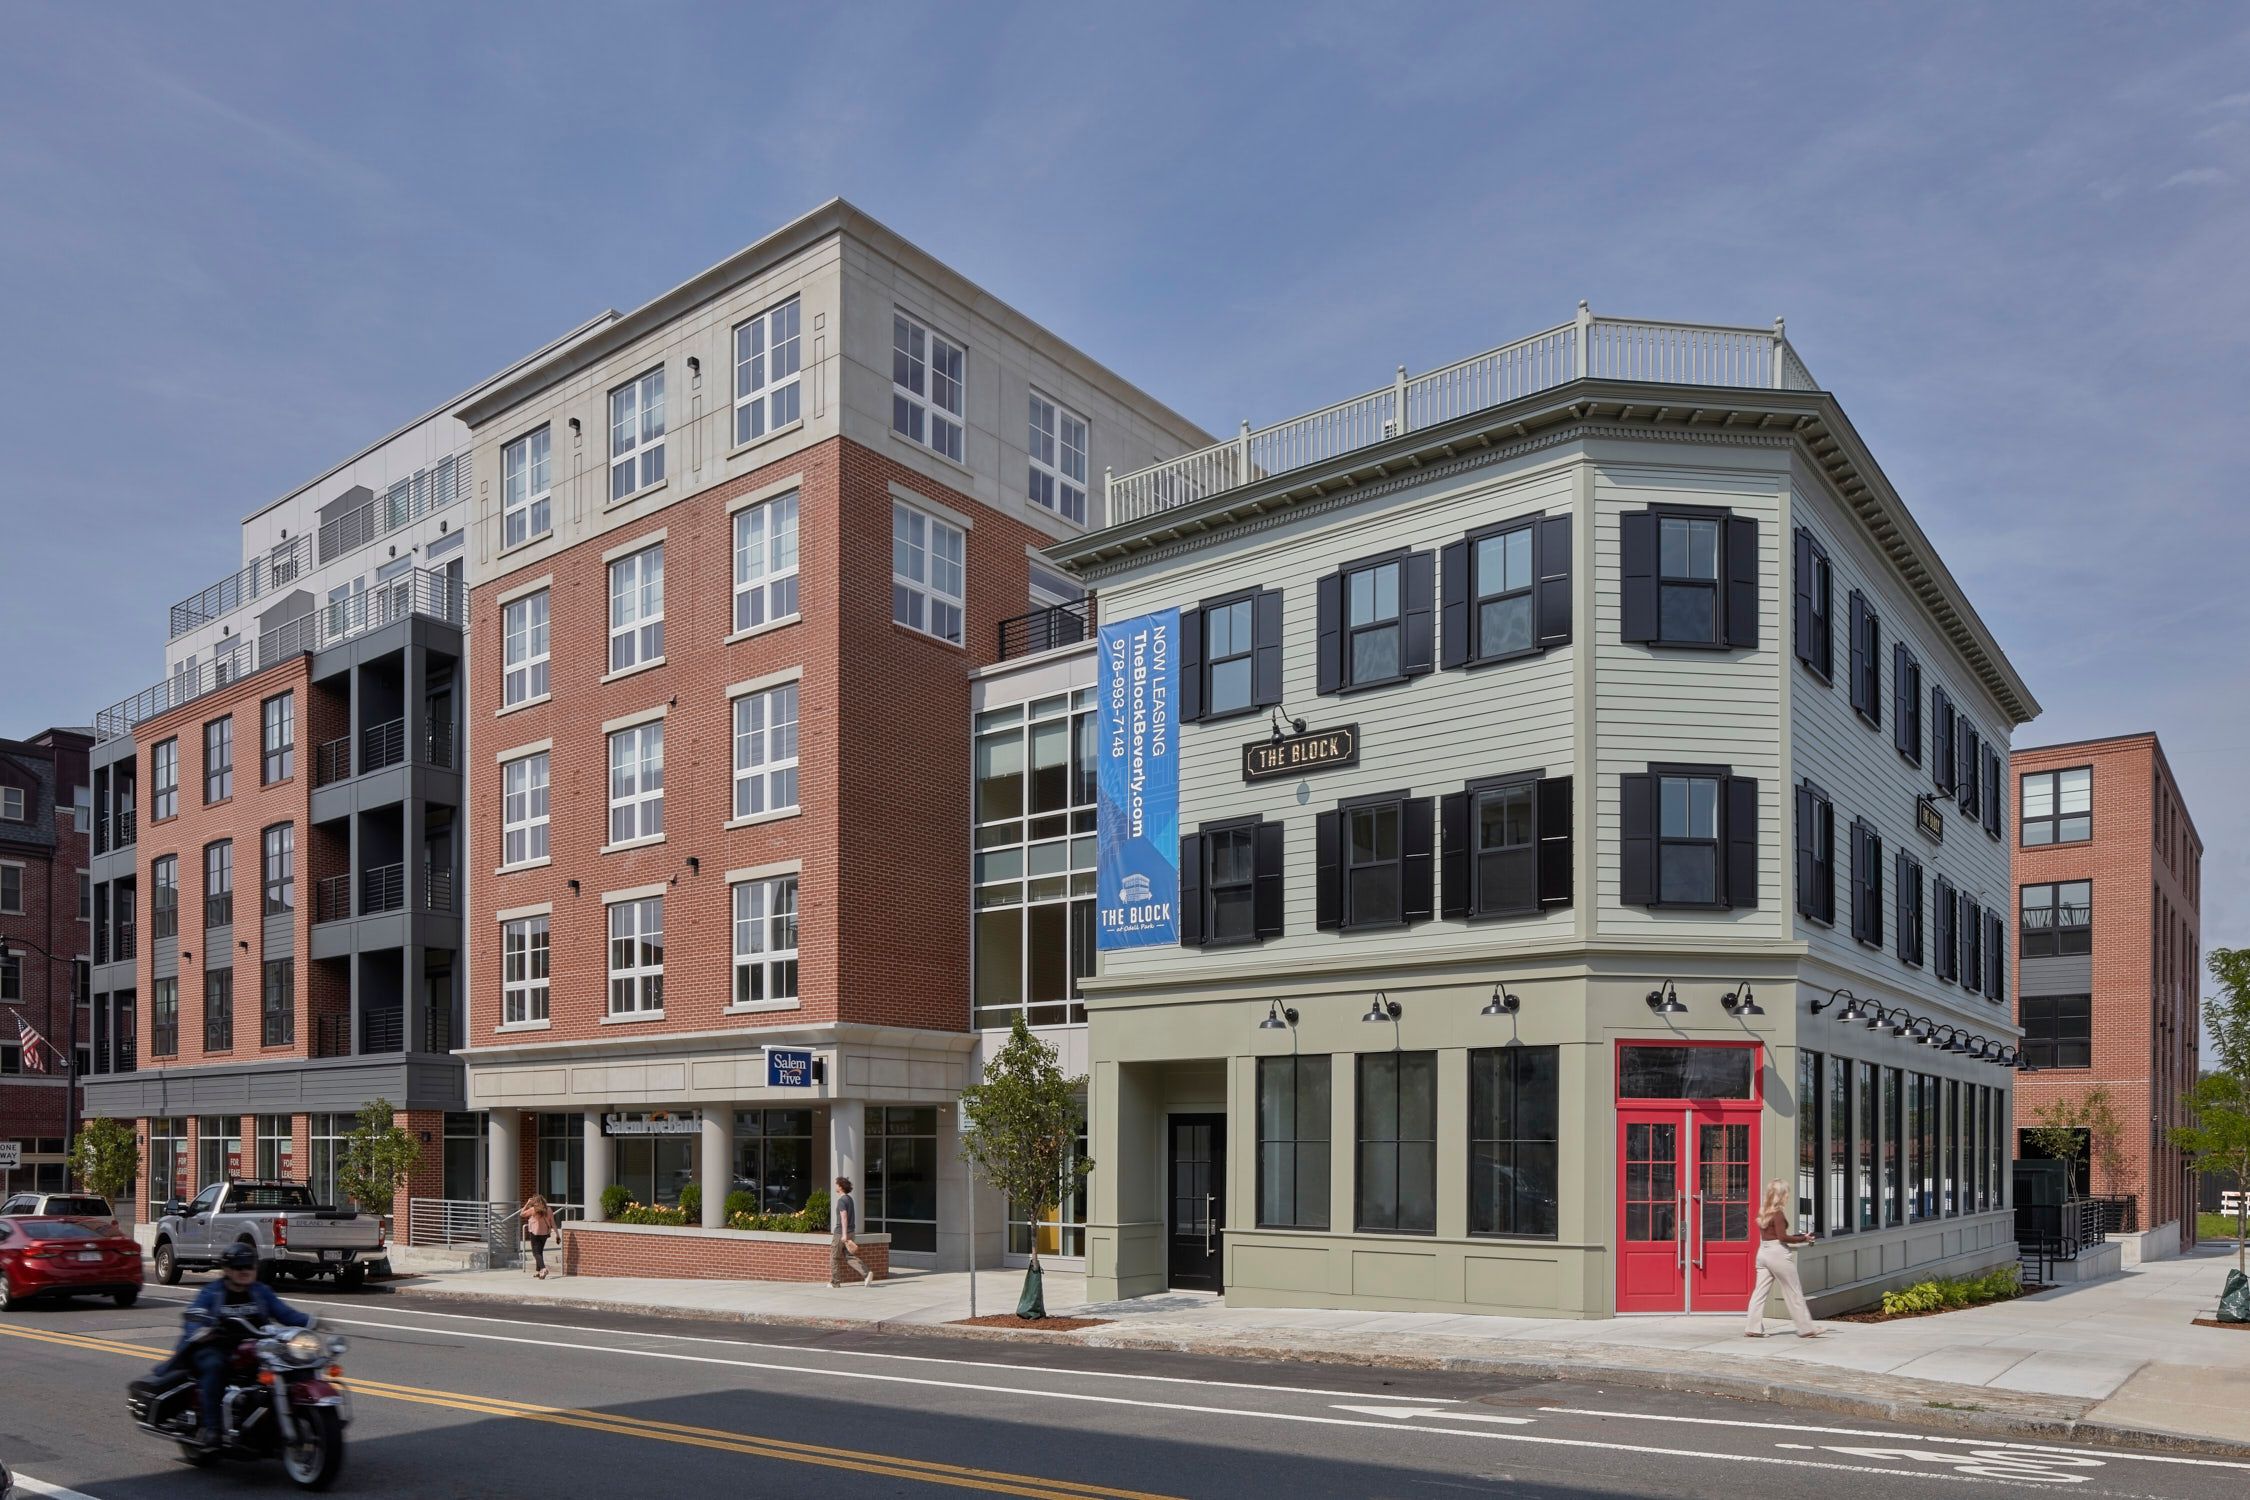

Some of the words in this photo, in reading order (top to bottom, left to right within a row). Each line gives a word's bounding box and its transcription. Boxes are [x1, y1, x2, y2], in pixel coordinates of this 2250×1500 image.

[1153, 625, 1166, 671] NOW
[1112, 639, 1125, 757] 978-993-7148
[1152, 677, 1166, 757] LEASING
[1130, 630, 1148, 838] TheBlockBeverly.com
[1259, 746, 1285, 768] THE
[1291, 736, 1339, 763] BLOCK
[1101, 908, 1124, 926] THE
[1130, 902, 1170, 924] BLOCK
[774, 1053, 807, 1069] Salem
[779, 1069, 802, 1085] Five
[230, 1157, 240, 1166] FOR
